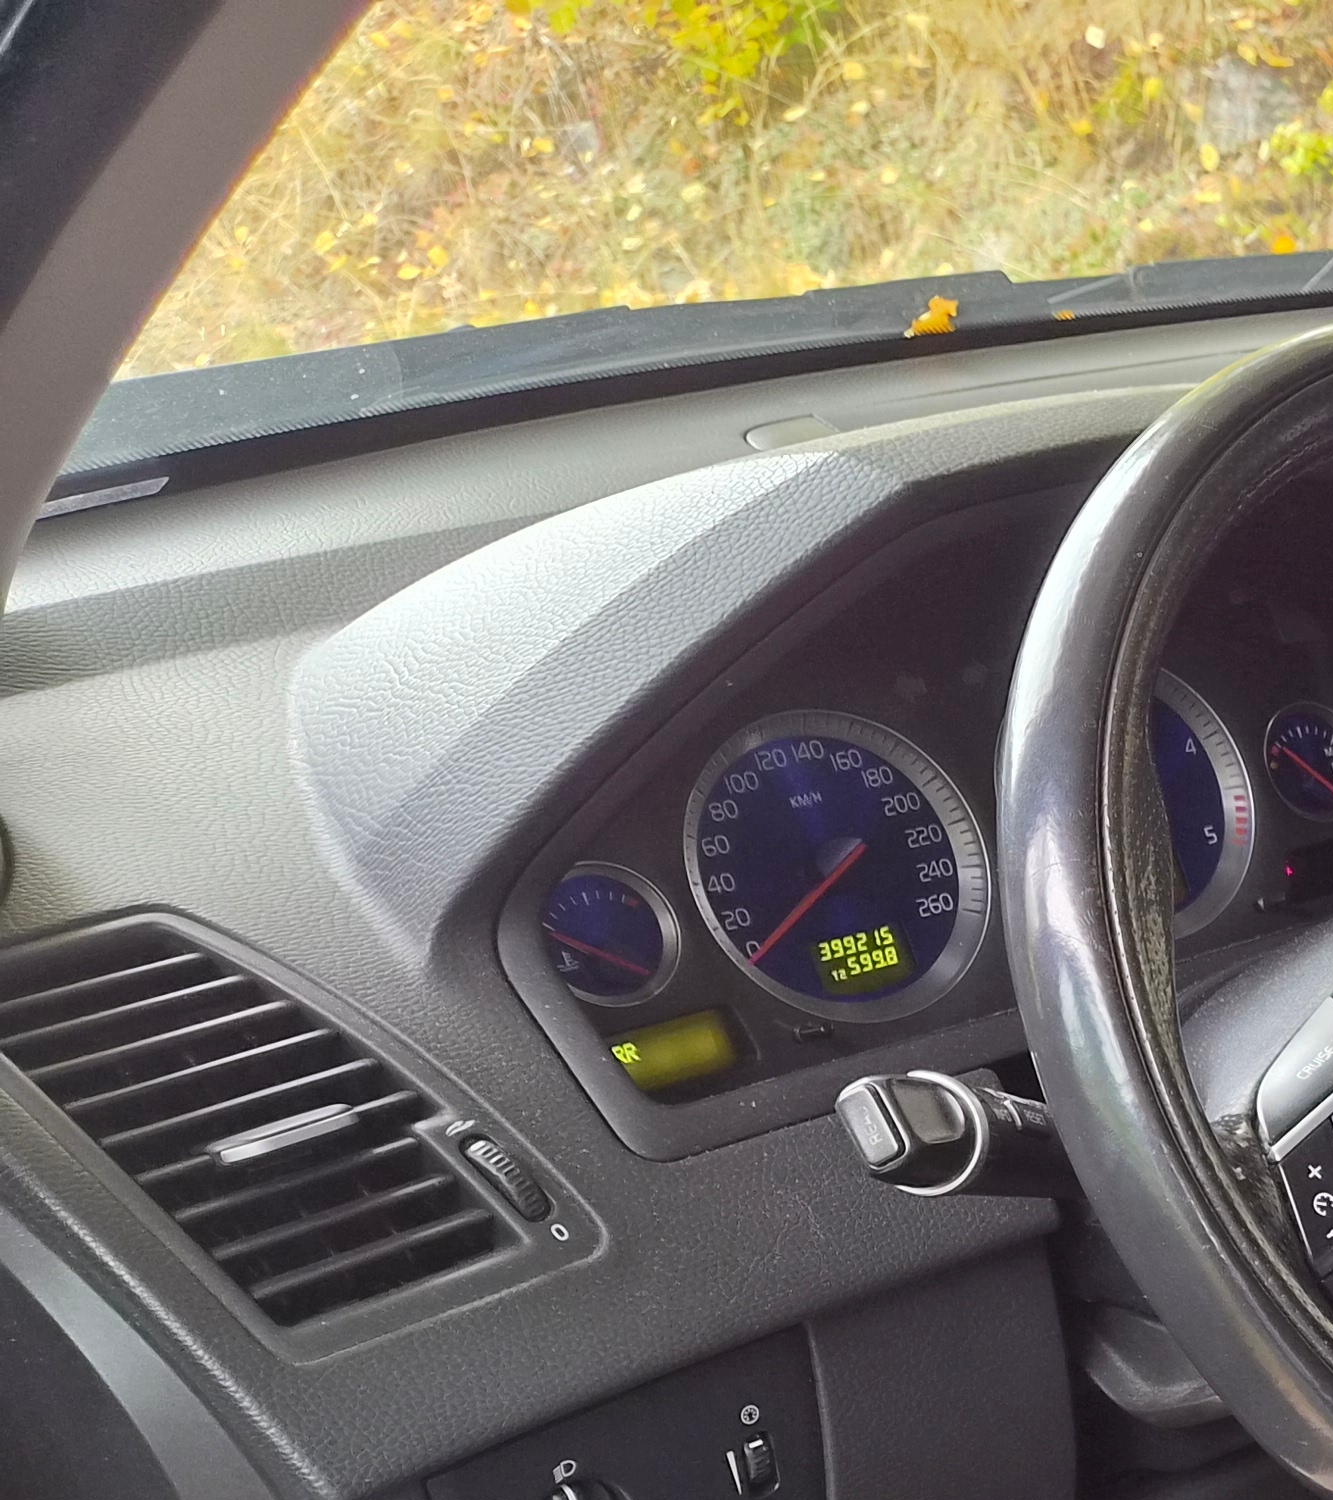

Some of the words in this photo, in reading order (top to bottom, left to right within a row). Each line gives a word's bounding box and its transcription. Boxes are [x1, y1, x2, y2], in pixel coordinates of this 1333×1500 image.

[791, 740, 824, 762] 140
[1185, 738, 1197, 755] 4
[754, 748, 787, 771] 120
[830, 749, 863, 772] 160
[724, 770, 759, 795] 100
[861, 766, 894, 788] 180
[708, 799, 739, 822] 80
[881, 792, 921, 816] 200
[701, 834, 730, 857] 60
[905, 824, 943, 848] 220
[1203, 826, 1218, 845] 5
[916, 858, 954, 883] 240
[707, 872, 736, 893] 40
[915, 892, 954, 917] 260
[721, 908, 750, 930] 20
